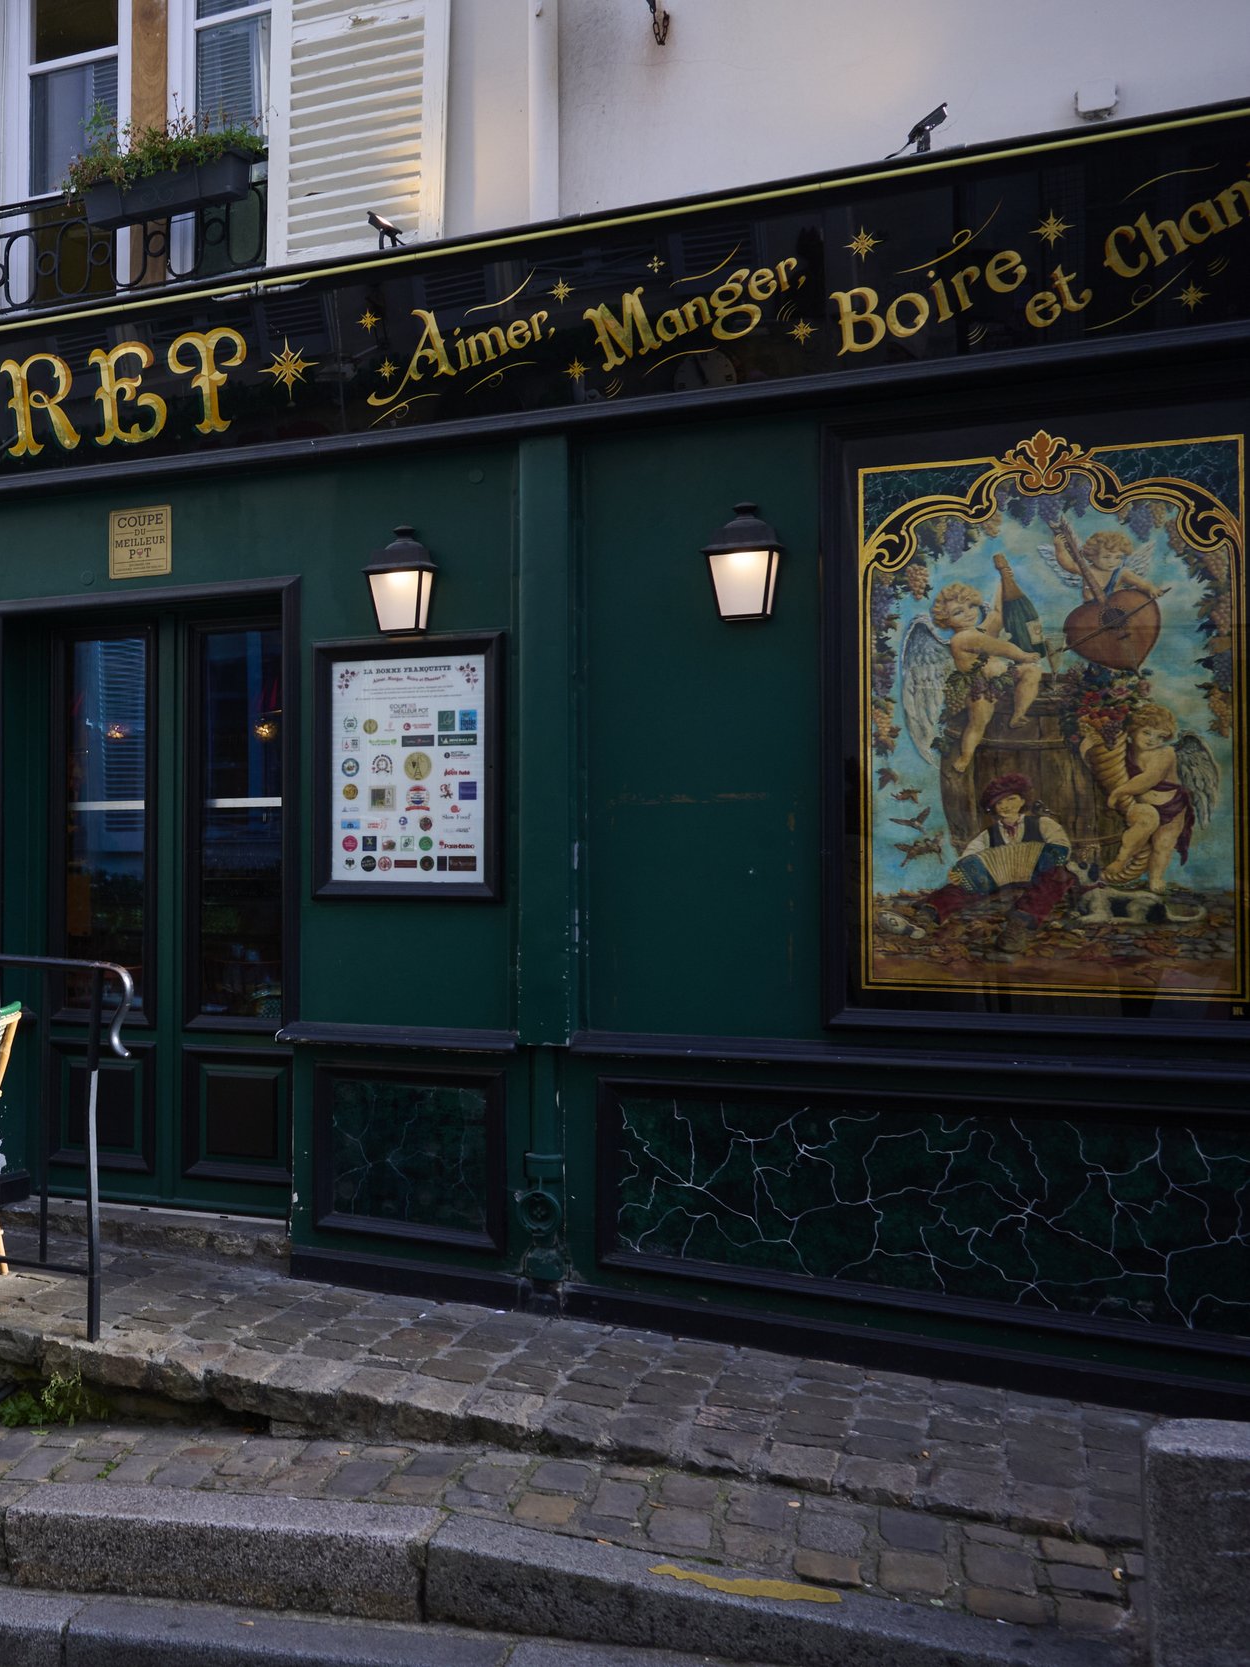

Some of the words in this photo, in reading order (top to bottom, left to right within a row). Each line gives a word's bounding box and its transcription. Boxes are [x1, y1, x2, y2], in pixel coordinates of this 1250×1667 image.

[366, 308, 556, 407] Aimer,
[583, 257, 807, 372] Manger,
[829, 250, 1028, 358] Boire
[1025, 264, 1092, 328] et
[1103, 172, 1250, 278] Chan
[117, 513, 164, 529] COUPE
[134, 528, 146, 536] DU
[115, 535, 166, 548] MEILLEUR
[403, 665, 452, 673] FRANQUETTE
